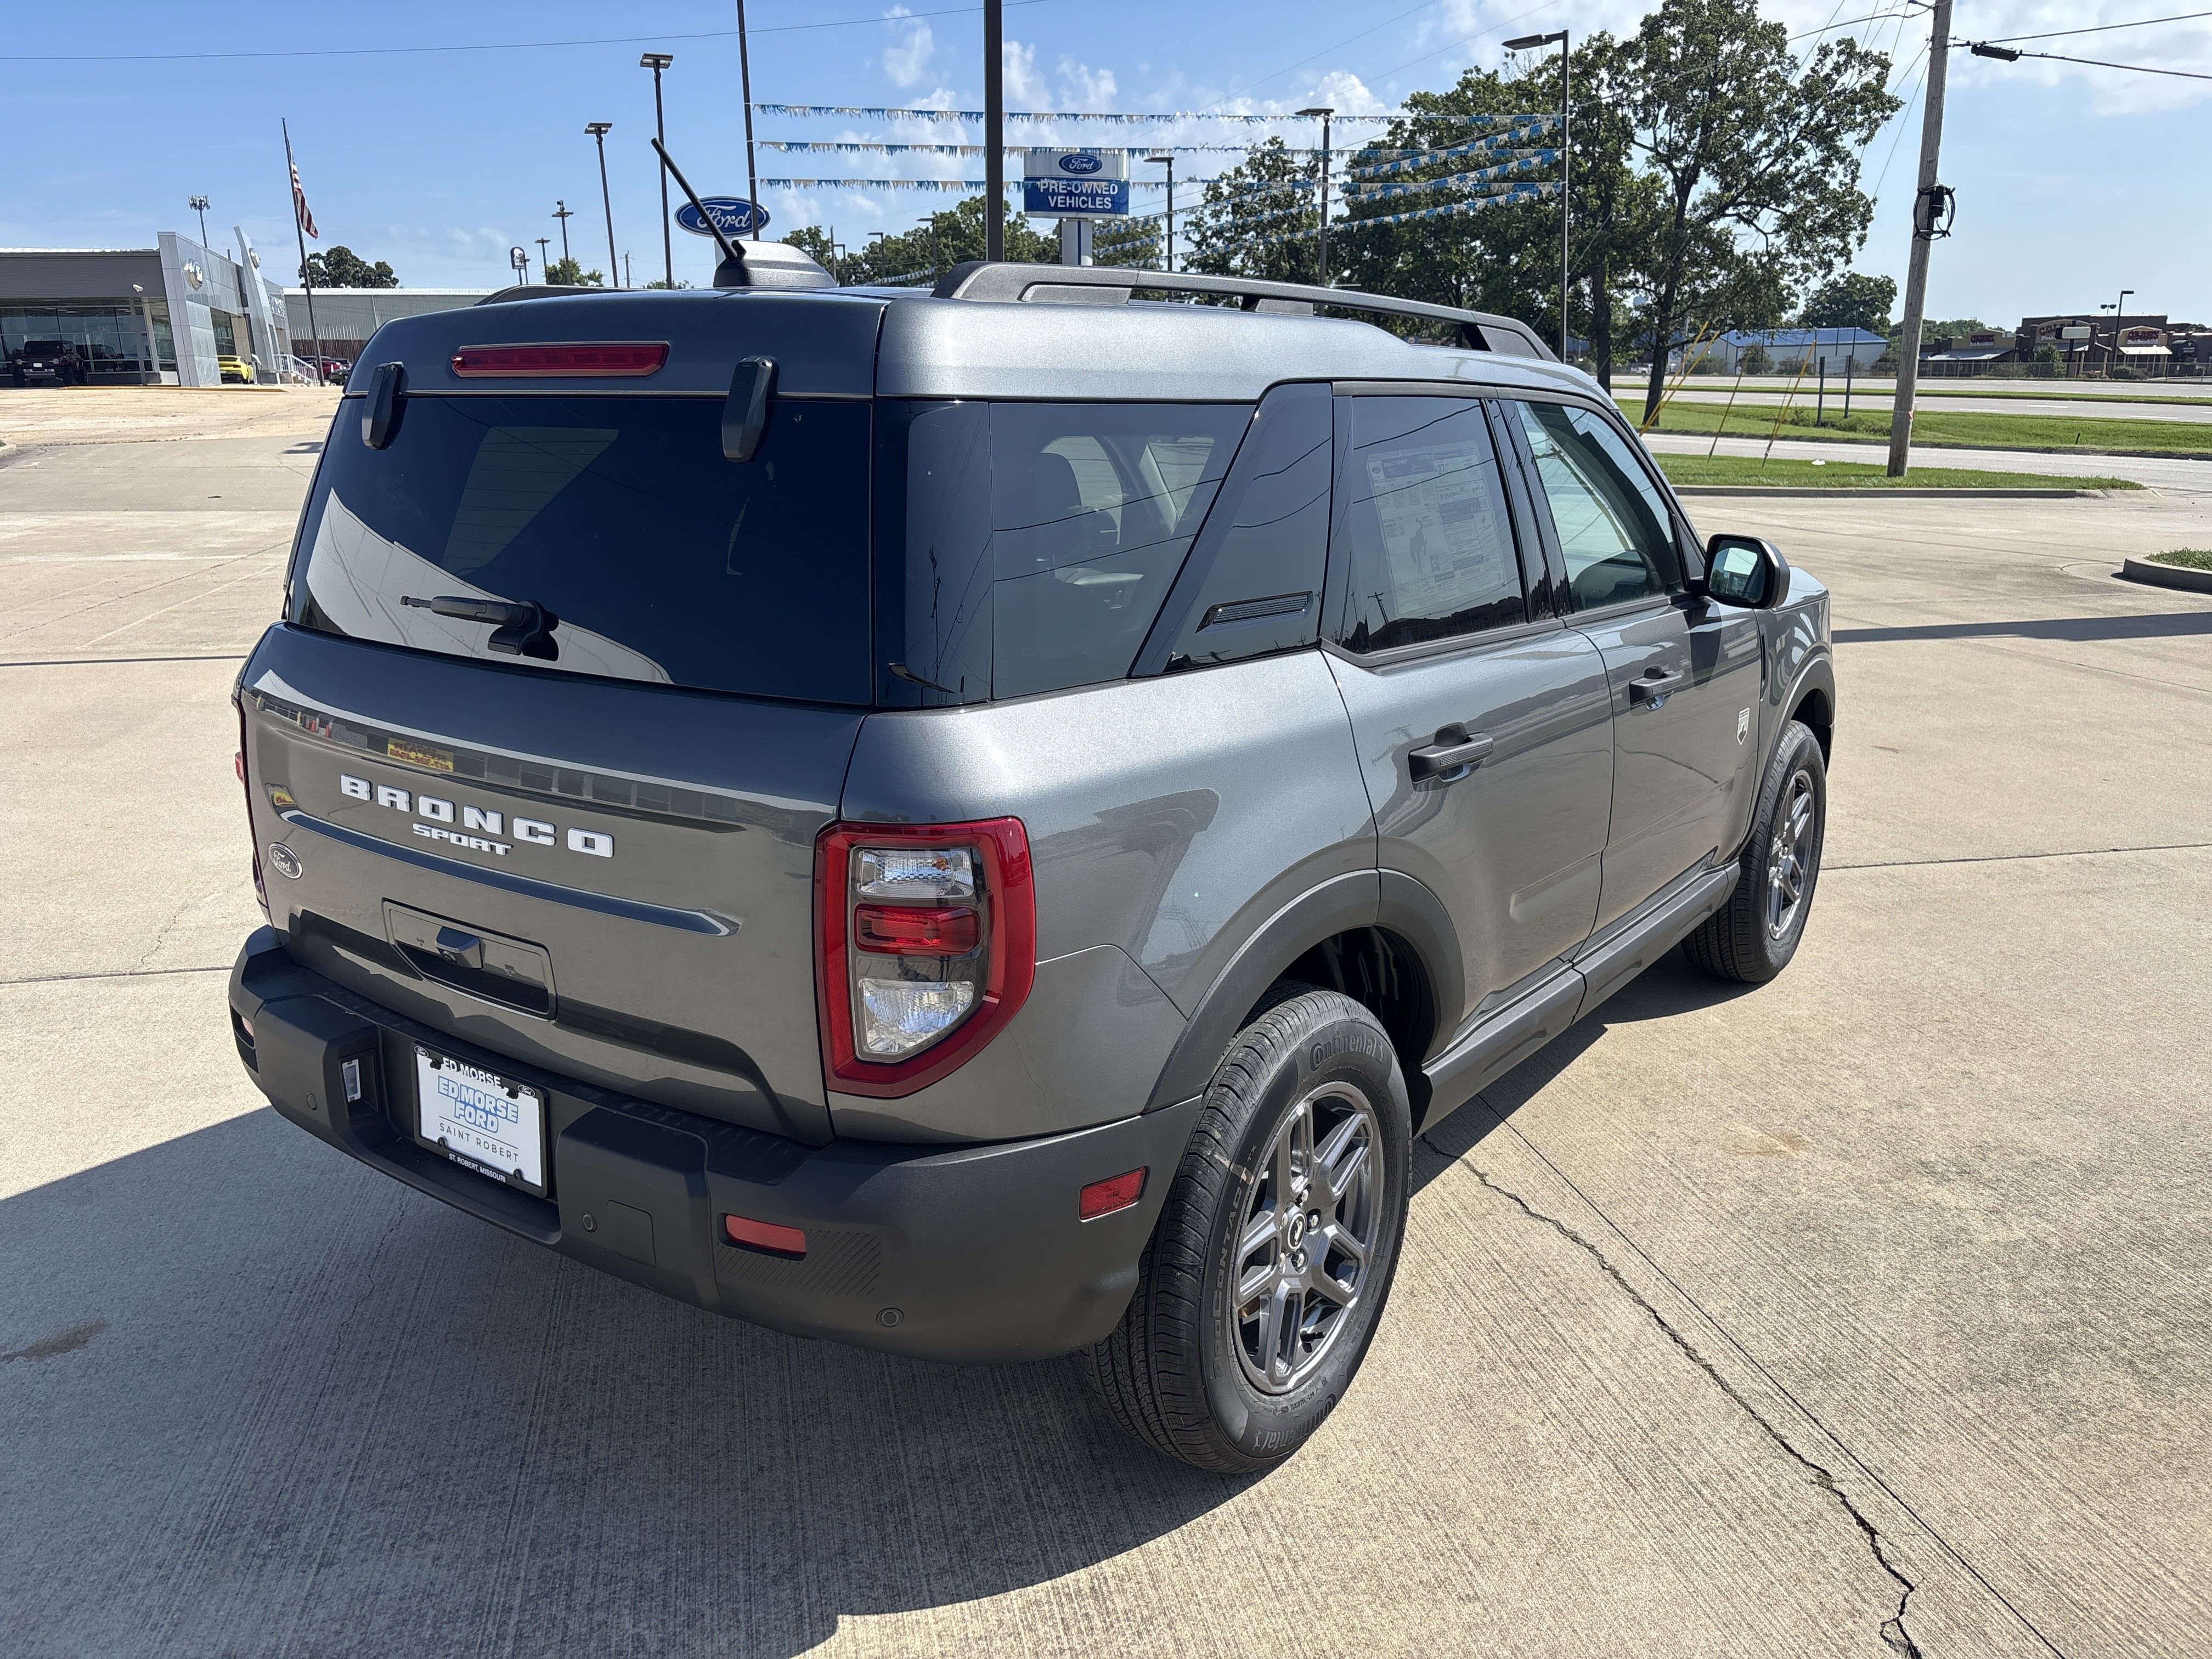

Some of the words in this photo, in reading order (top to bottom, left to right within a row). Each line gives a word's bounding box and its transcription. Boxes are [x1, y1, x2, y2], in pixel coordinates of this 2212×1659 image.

[1070, 157, 1094, 170] Ford
[1040, 182, 1118, 195] PRE-OWNED
[1048, 195, 1112, 209] VEHICLES
[696, 205, 751, 228] Ford
[341, 773, 614, 858] BRONCO
[413, 823, 514, 855] SPORT
[273, 850, 291, 872] Ford
[1310, 1030, 1377, 1072] Continental
[443, 1057, 457, 1071] ED
[460, 1063, 501, 1087] MORSE
[438, 1075, 459, 1099] ED
[459, 1084, 518, 1124] MORSE
[454, 1100, 499, 1134] FORD
[440, 1122, 470, 1142] SAINT
[476, 1137, 518, 1162] ROBERT
[457, 1157, 479, 1173] ROBERT,
[479, 1166, 506, 1183] MISSOURI
